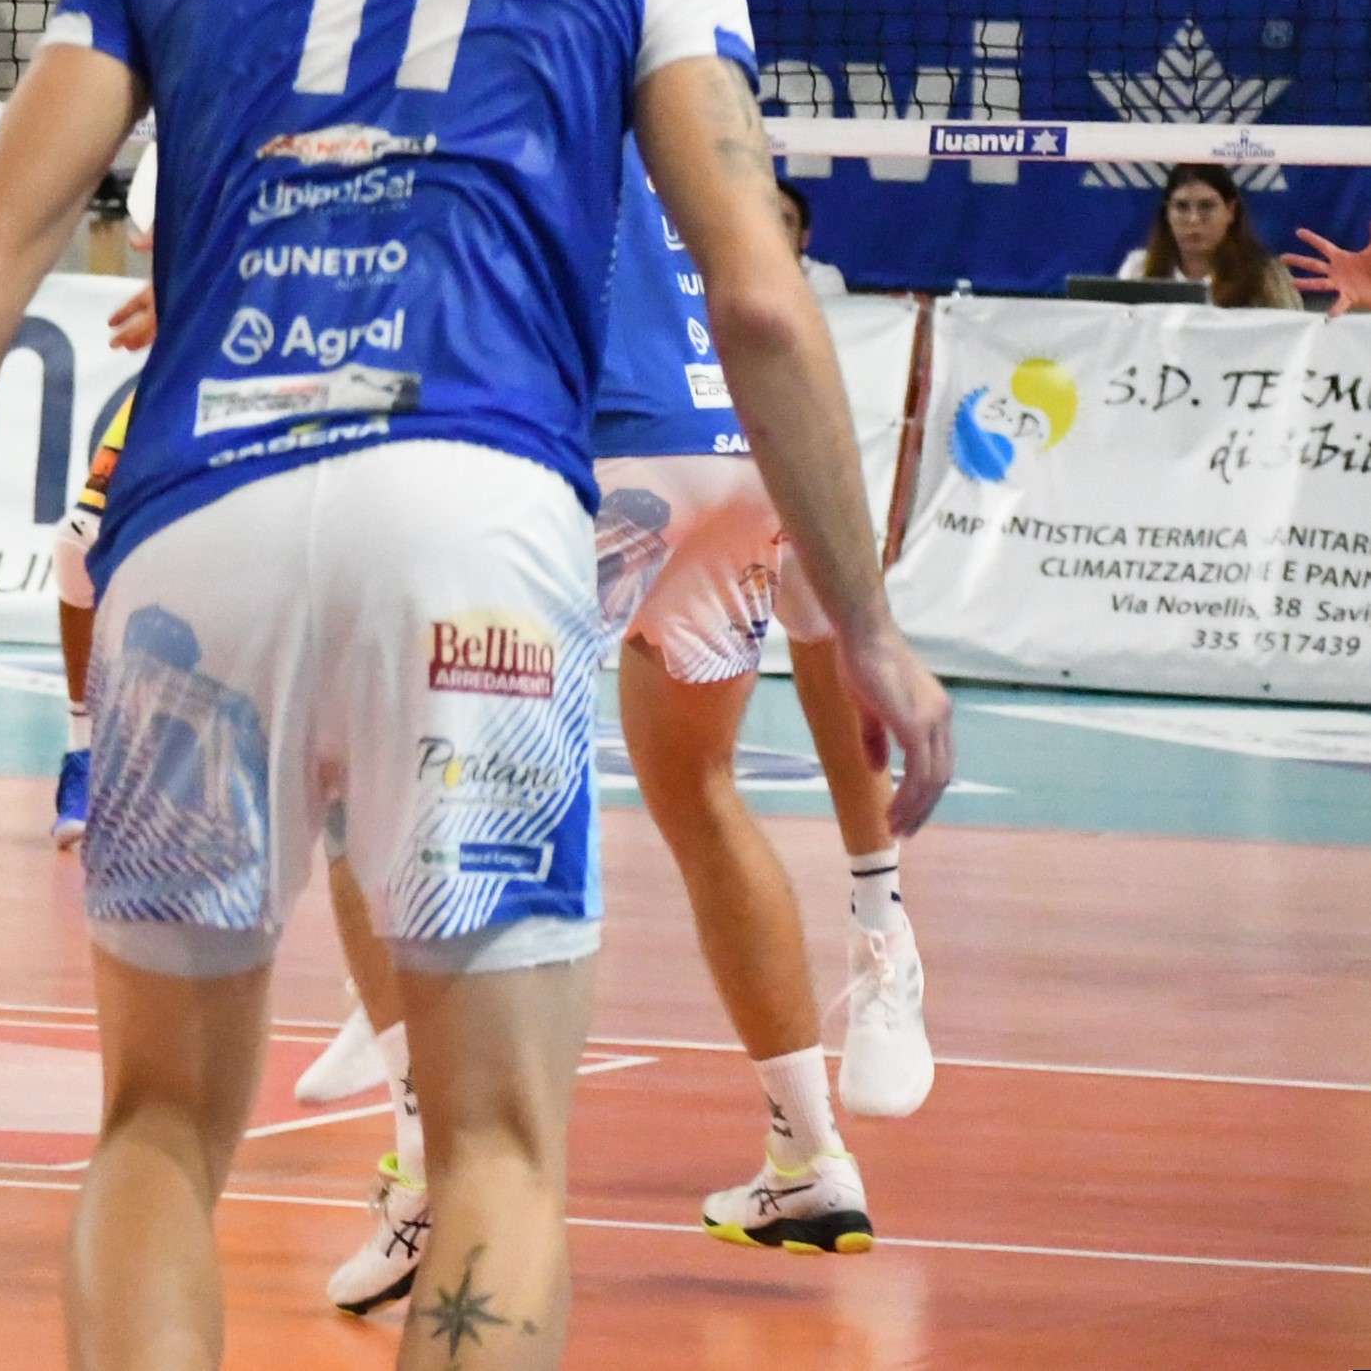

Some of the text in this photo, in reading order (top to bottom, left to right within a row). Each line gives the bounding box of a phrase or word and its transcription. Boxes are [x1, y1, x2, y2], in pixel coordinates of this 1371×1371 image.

[239, 239, 408, 281] GUNETTO
[281, 309, 406, 367] Agral
[936, 512, 1127, 546] IMPNTISTICA
[1137, 525, 1248, 550] TERMICA
[1040, 557, 1274, 585] CLIMATIZZAZIOE
[1282, 561, 1295, 582] E
[1111, 593, 1149, 617] Via
[1272, 595, 1302, 619] 38
[1316, 600, 1371, 629] Savi
[430, 621, 555, 673] Bellino
[1191, 629, 1239, 652] 335
